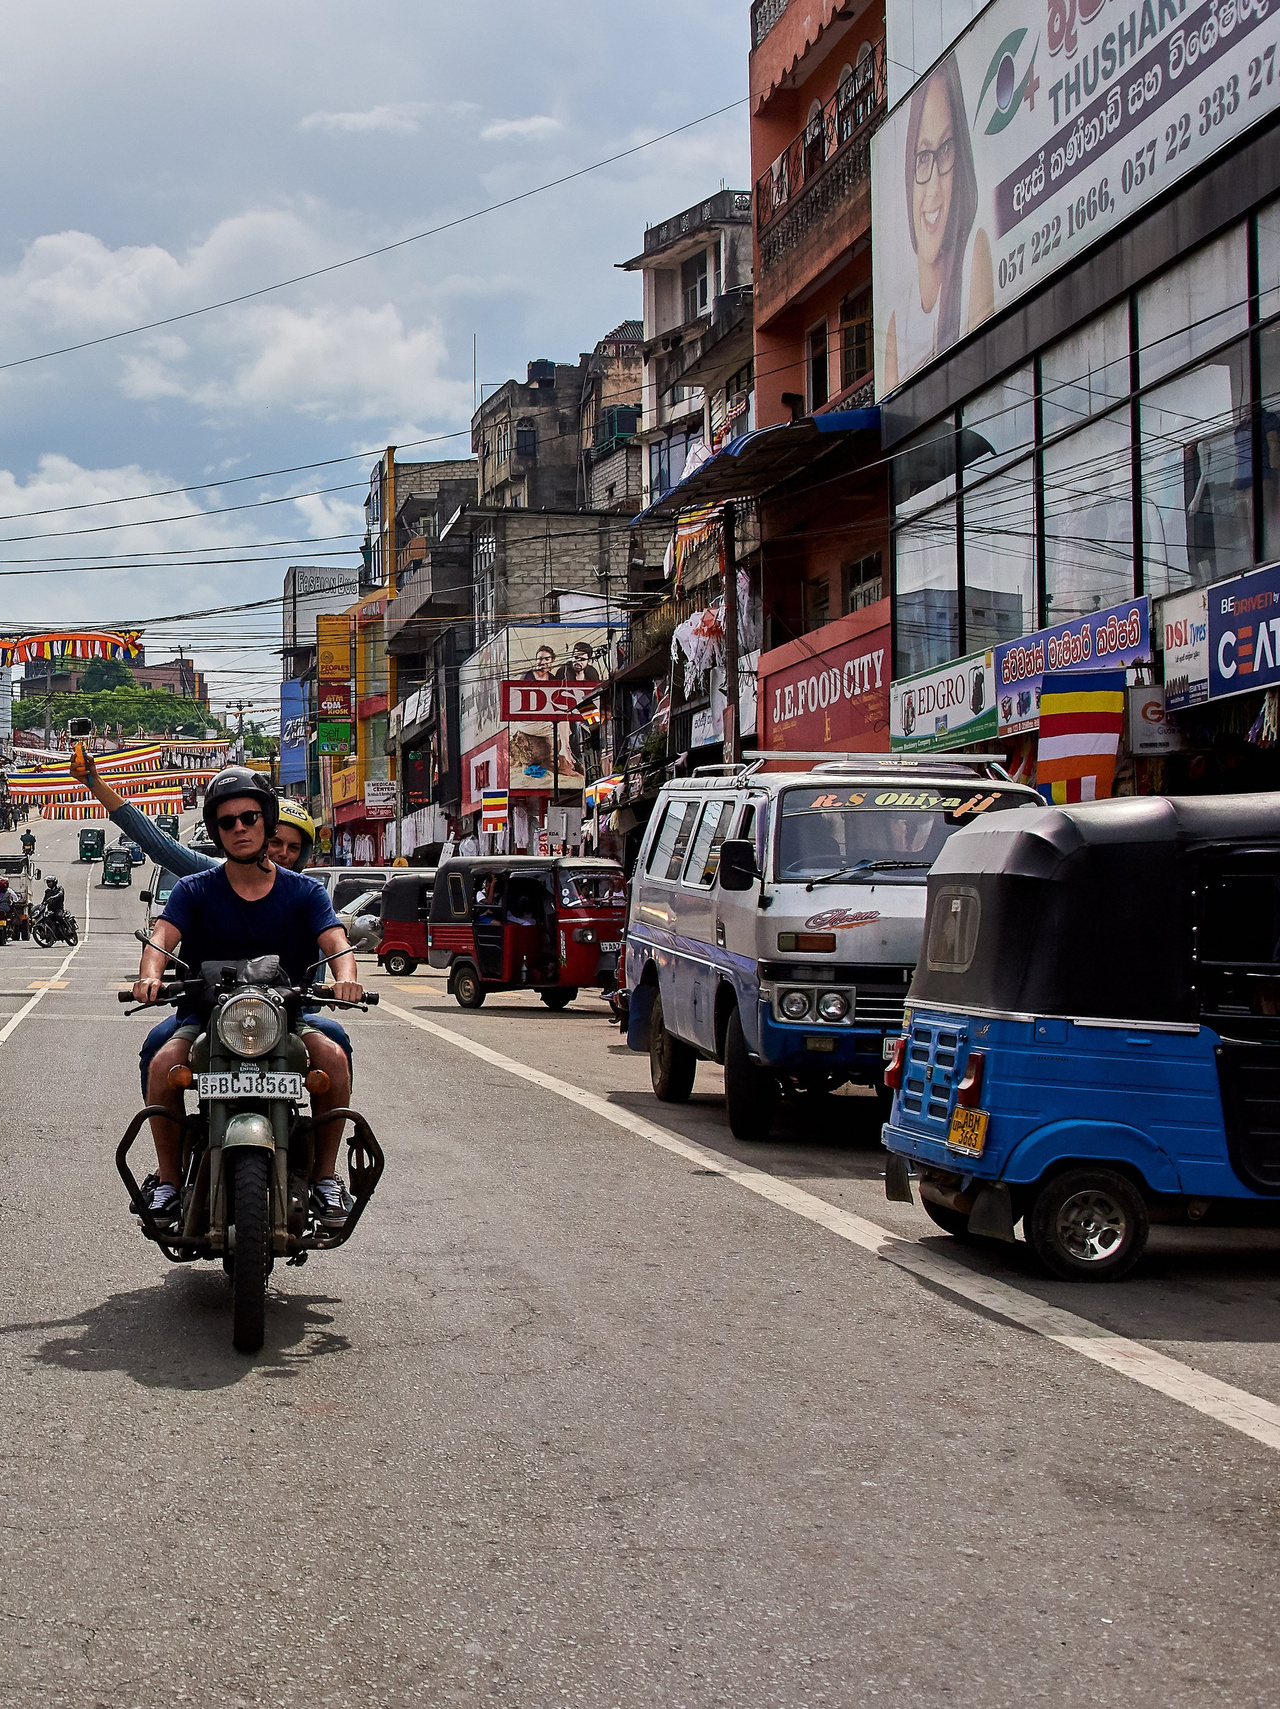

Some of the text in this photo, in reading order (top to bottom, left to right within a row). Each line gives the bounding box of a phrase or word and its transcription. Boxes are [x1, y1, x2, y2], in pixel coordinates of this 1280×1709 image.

[1049, 0, 1187, 126] THUSHAR
[998, 242, 1026, 289] 057
[1031, 215, 1062, 266] 222
[1067, 177, 1115, 239] 1666,
[1121, 138, 1157, 194] 057
[1164, 113, 1192, 164] 22
[1199, 74, 1240, 136] 333
[298, 571, 358, 594] FASHION BUG
[1220, 596, 1235, 615] BE
[1233, 592, 1272, 616] DRIVEN
[1165, 619, 1206, 650] DSI Tyres
[843, 649, 885, 699] CITY
[321, 702, 341, 710] CDM
[918, 674, 965, 716] EDGRO
[321, 727, 339, 738] Self
[201, 1085, 217, 1094] SP
[958, 1129, 978, 1148] 3663
